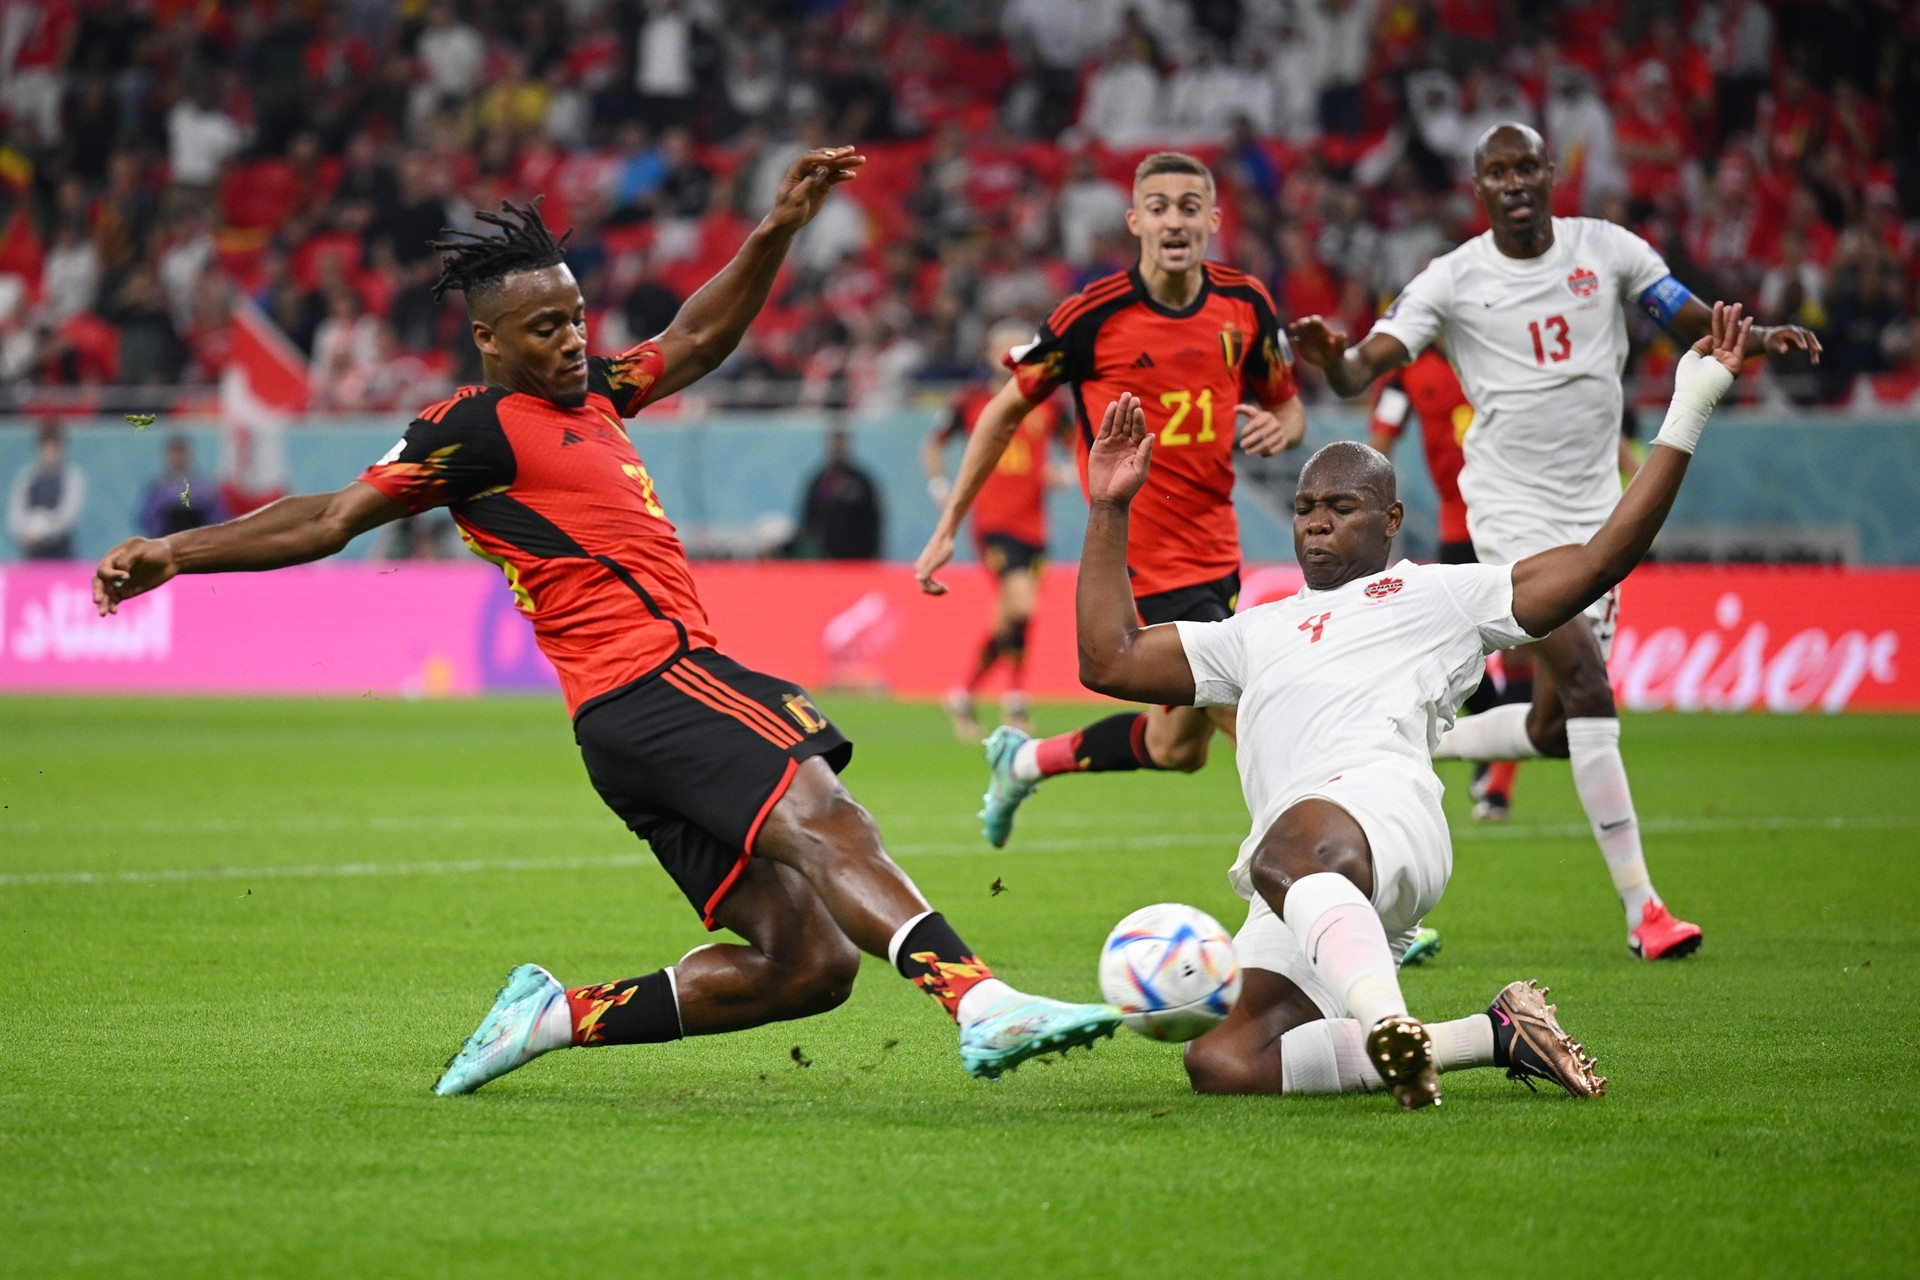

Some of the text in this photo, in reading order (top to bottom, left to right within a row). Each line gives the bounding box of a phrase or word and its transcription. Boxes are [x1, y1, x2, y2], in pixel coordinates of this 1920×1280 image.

[1528, 314, 1572, 366] 13
[1159, 388, 1216, 446] 21
[1298, 611, 1331, 643] 4
